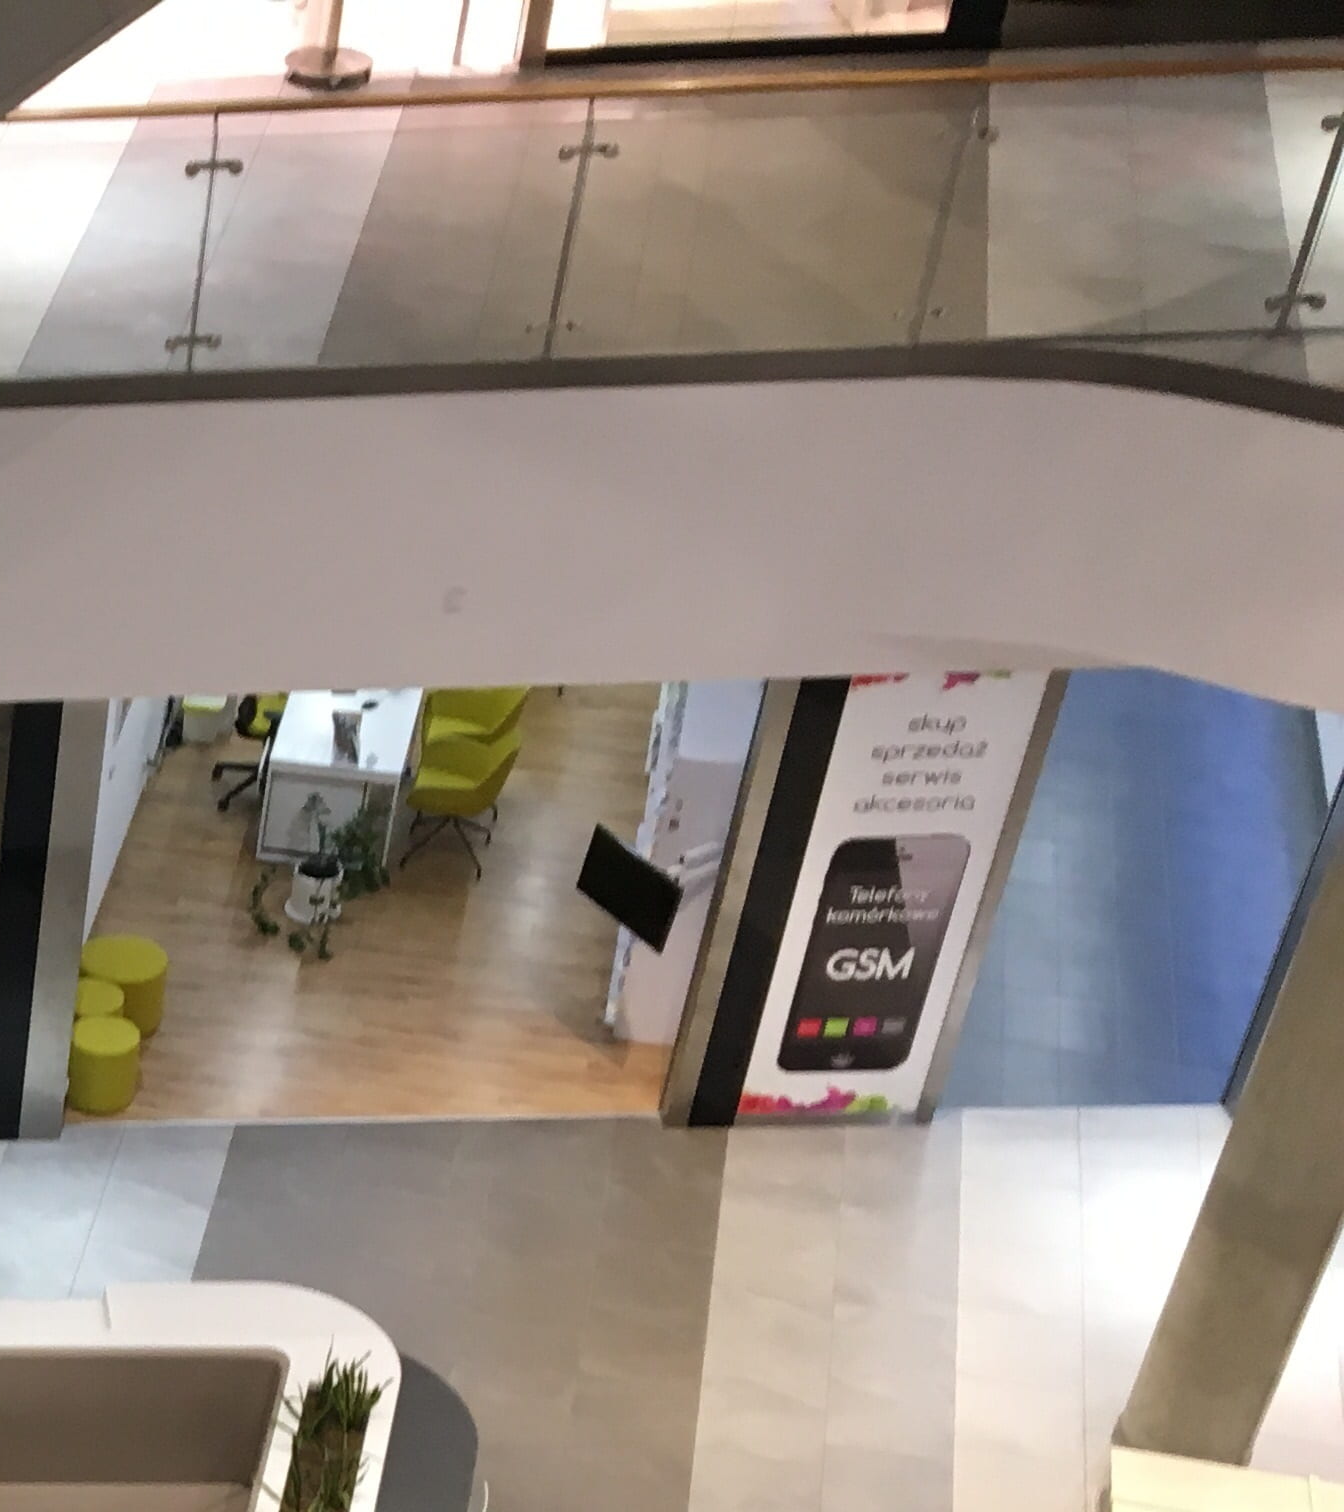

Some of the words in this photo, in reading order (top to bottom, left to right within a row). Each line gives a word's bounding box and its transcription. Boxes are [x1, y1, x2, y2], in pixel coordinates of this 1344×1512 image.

[909, 713, 967, 735] skup
[870, 739, 989, 763] sprzedaż
[881, 770, 962, 786] serwis
[852, 793, 976, 813] akcesoria
[825, 946, 915, 982] GSM
